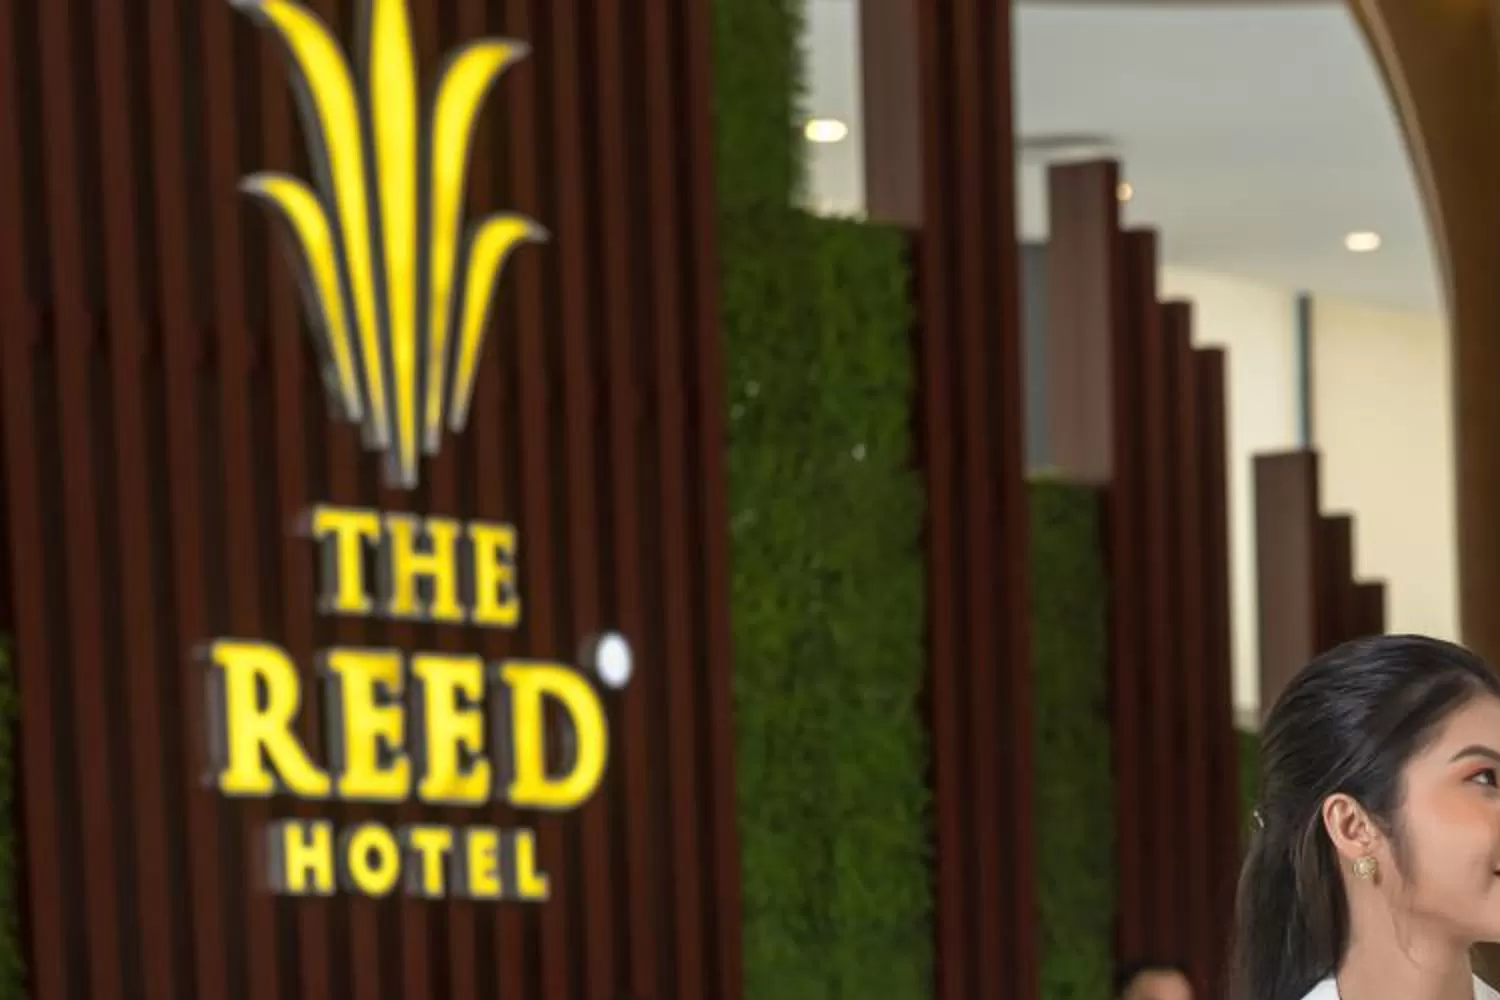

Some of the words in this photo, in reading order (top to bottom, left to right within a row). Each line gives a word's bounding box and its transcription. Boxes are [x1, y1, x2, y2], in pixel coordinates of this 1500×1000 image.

[312, 505, 521, 627] THE
[211, 639, 609, 811] REED
[281, 820, 550, 900] HOTEL
